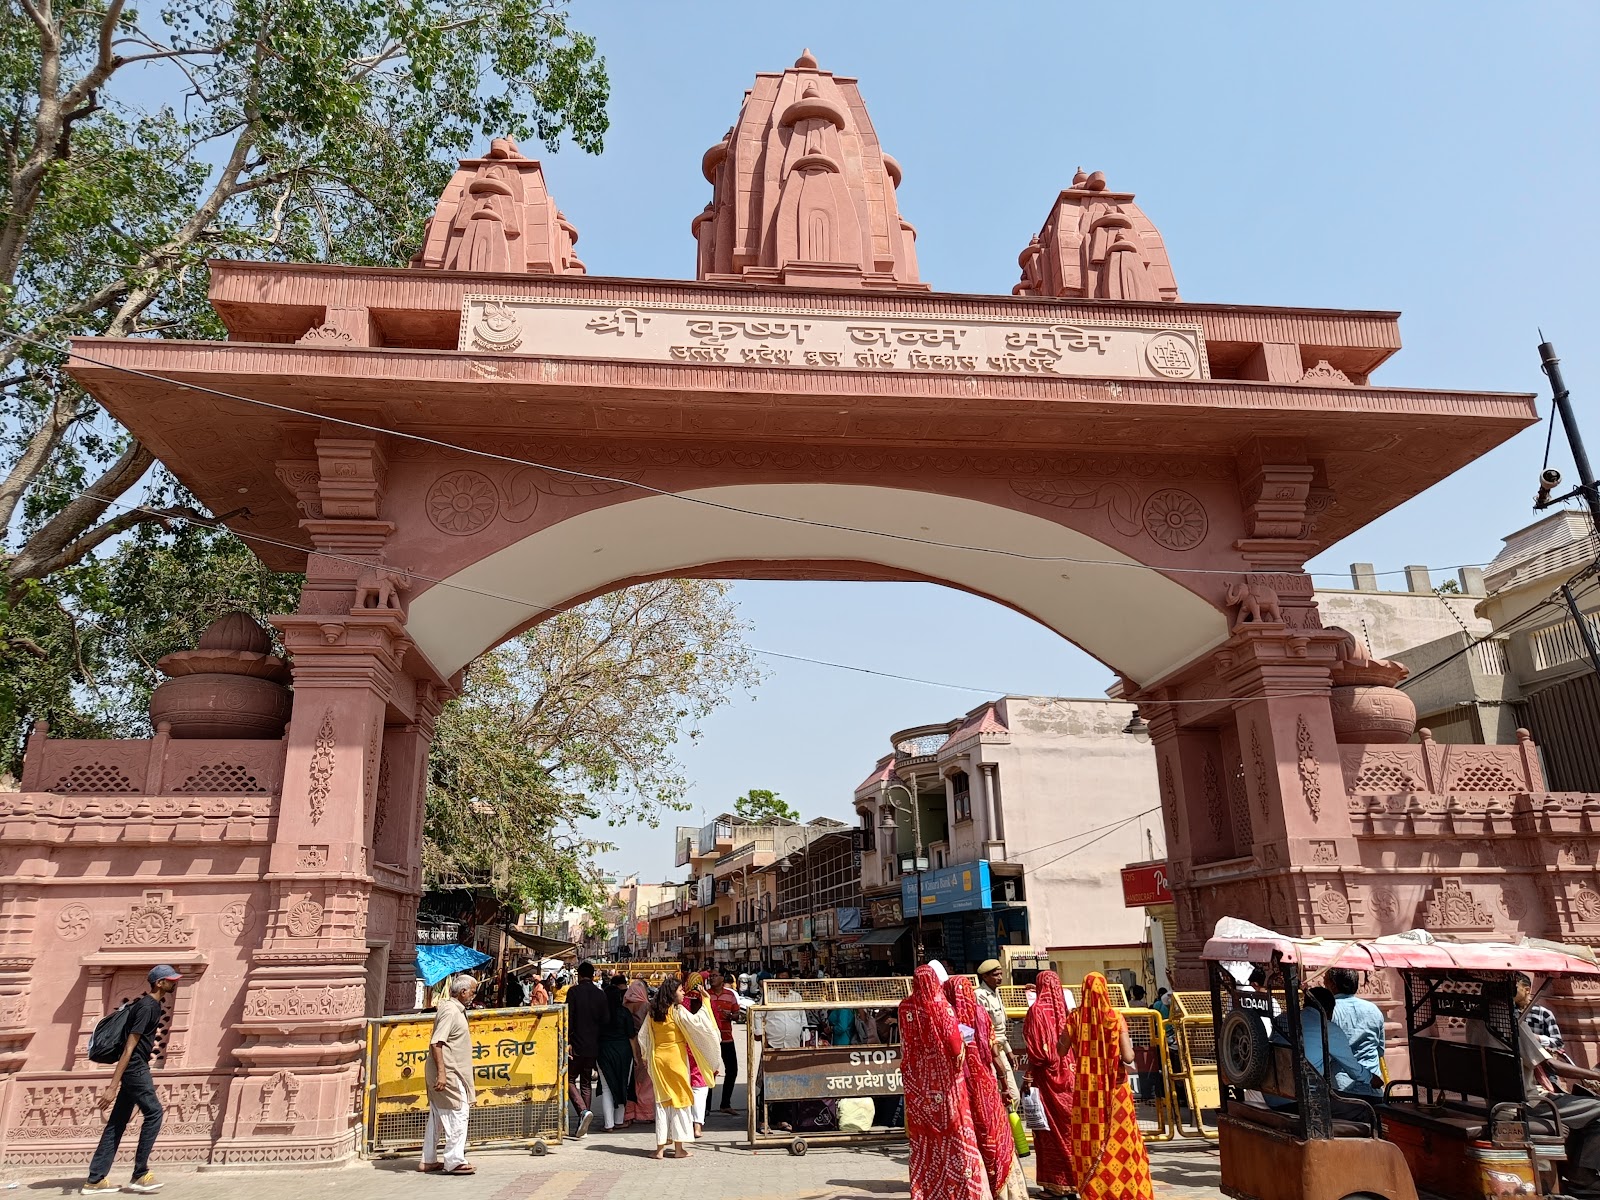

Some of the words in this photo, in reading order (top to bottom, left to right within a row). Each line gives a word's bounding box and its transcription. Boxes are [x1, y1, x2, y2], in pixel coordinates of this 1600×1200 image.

[587, 308, 650, 337] श्री
[687, 319, 811, 346] कृष्ण
[846, 326, 966, 350] जन्म
[1005, 325, 1111, 357] भूमि
[669, 345, 729, 362] उत्तर
[740, 344, 793, 364] प्रदेश
[803, 351, 842, 367] ब्रज
[853, 348, 898, 369] तीर्थ
[908, 349, 978, 371] विकास
[986, 353, 1060, 374] परिषद
[497, 1038, 536, 1058] लिए
[850, 1050, 896, 1066] STOP
[826, 1076, 853, 1090] उत्तर
[854, 1070, 884, 1091] प्रदेश
